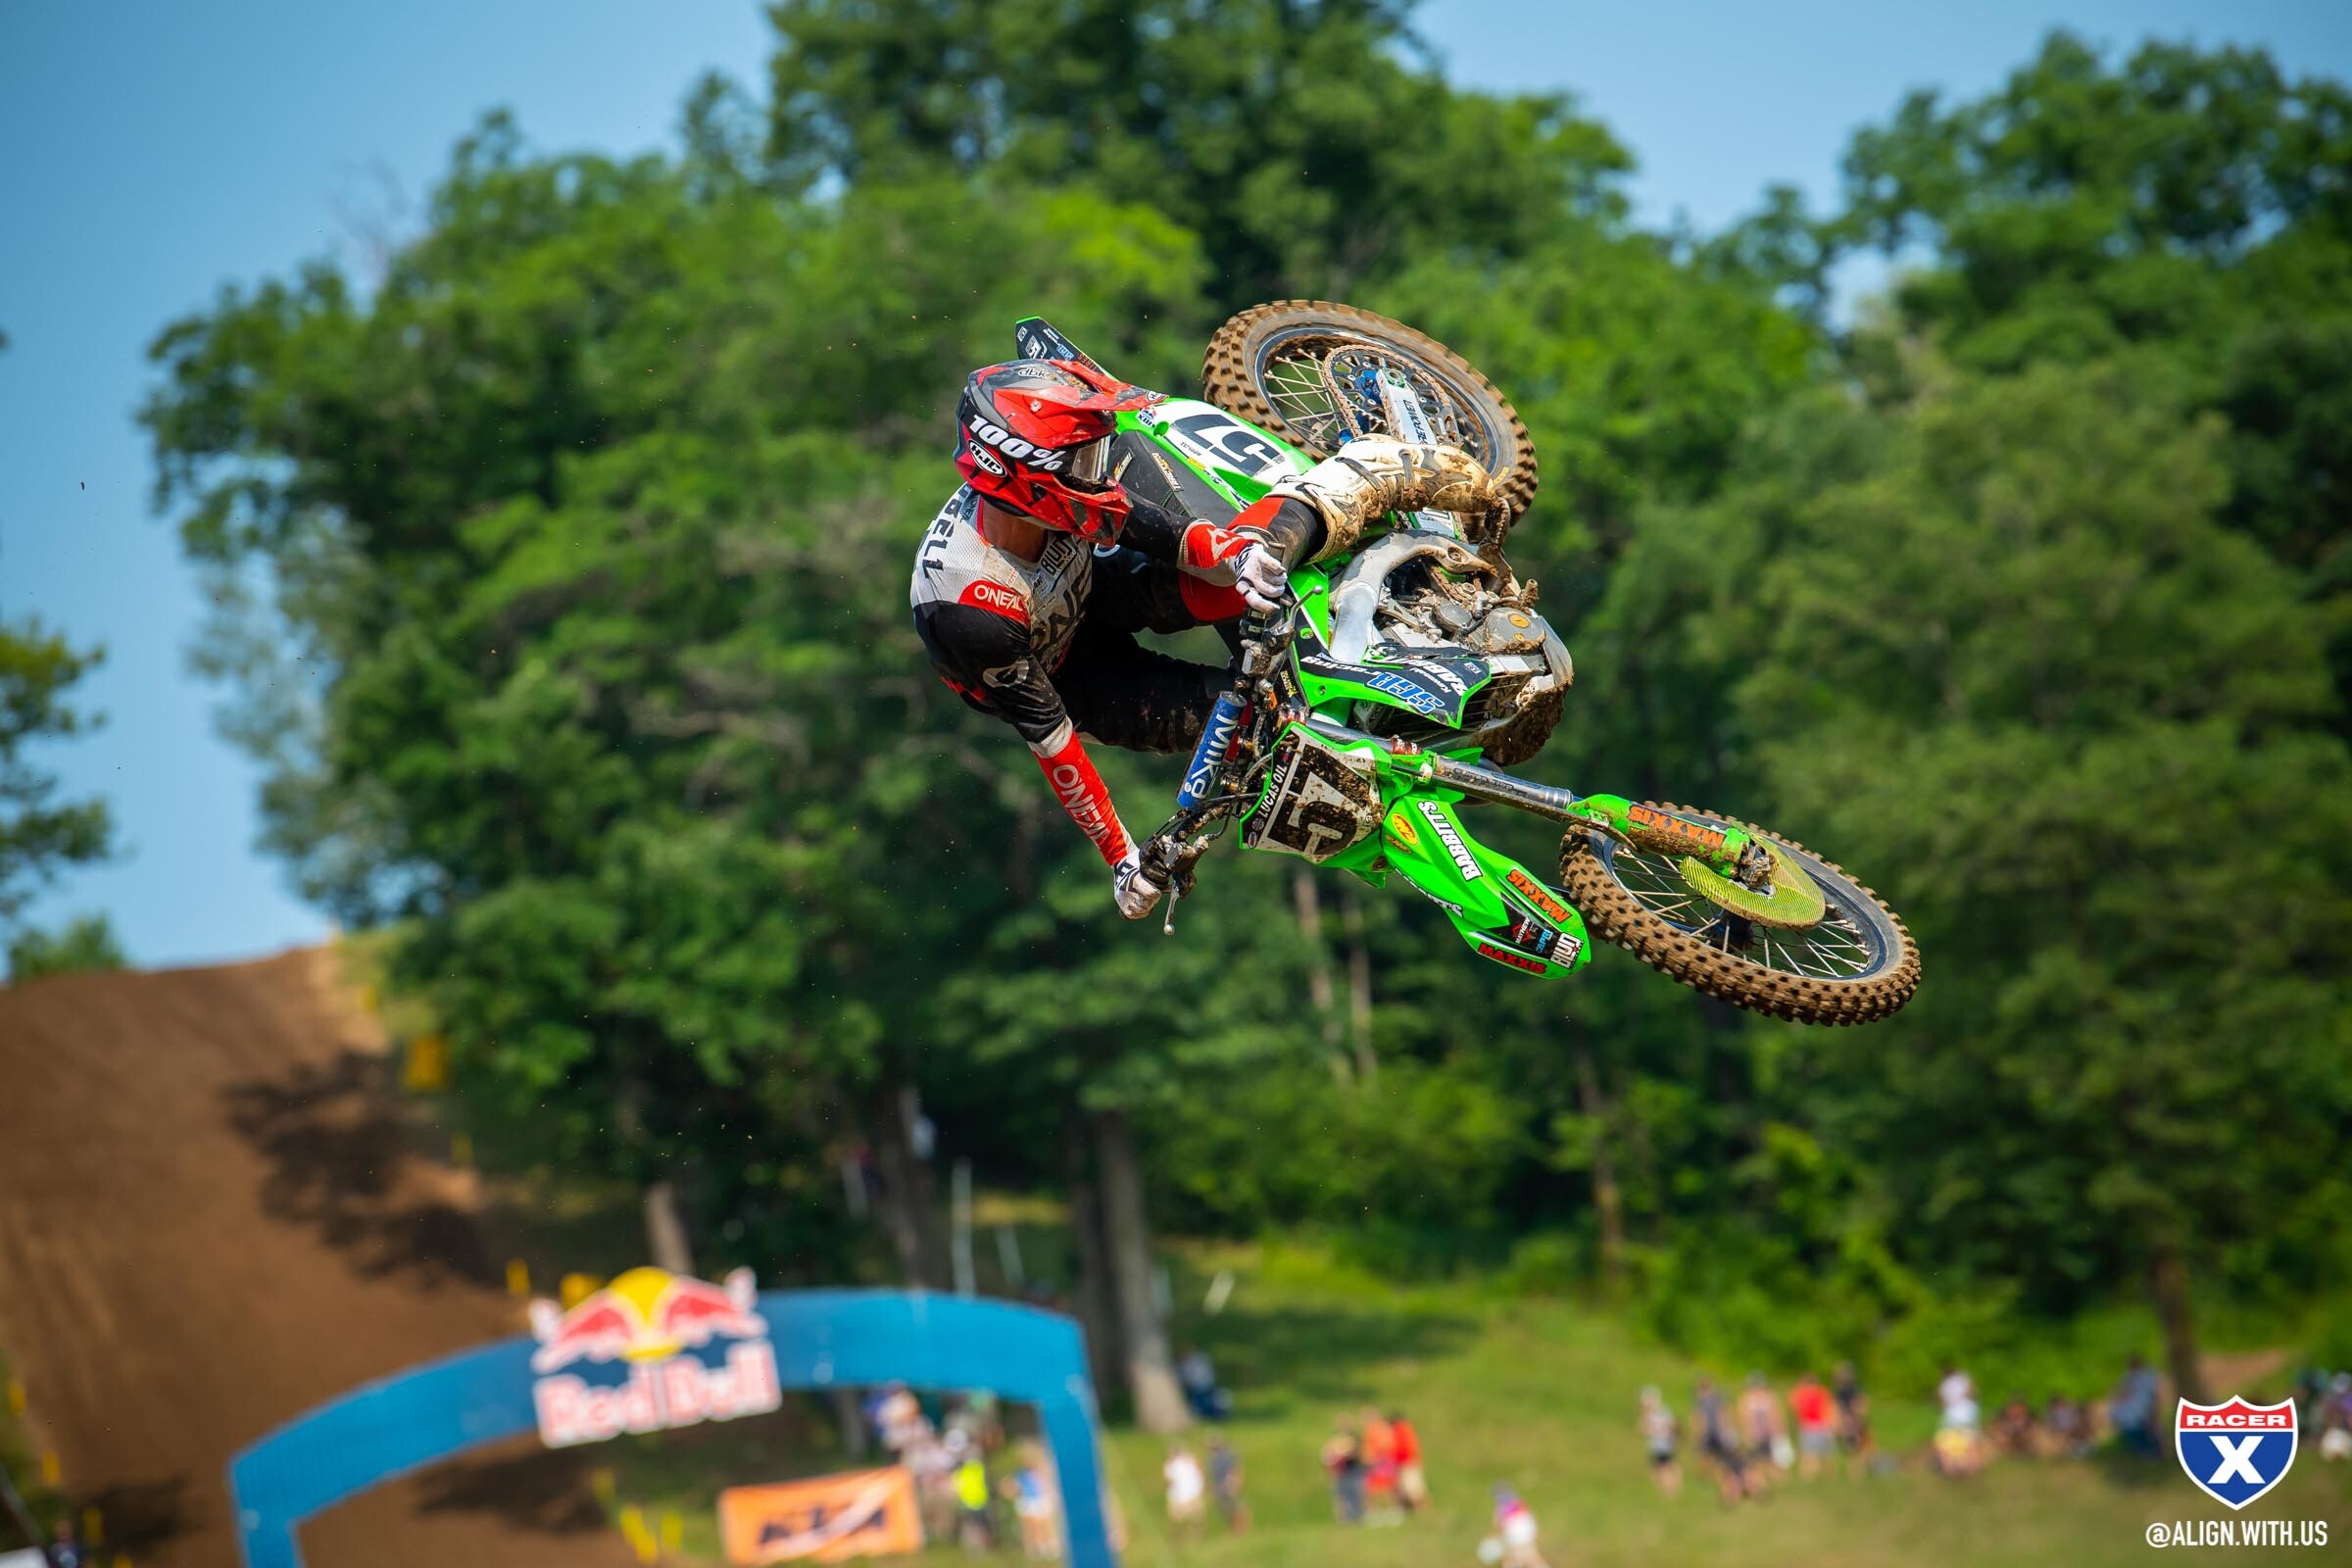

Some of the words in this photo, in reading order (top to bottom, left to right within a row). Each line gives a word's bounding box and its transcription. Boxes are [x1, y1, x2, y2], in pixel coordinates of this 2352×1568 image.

[969, 415, 1066, 470] 100%
[971, 445, 1002, 473] HJC
[1170, 415, 1281, 477] 57
[1366, 672, 1446, 713] SGB
[1258, 782, 1280, 818] LUCAS
[1273, 764, 1288, 783] OIL
[1267, 744, 1371, 855] 57
[1418, 801, 1483, 881] BABBITT'S
[1629, 806, 1726, 848] MAXXIS
[1506, 869, 1572, 923] MAXXIS
[1478, 943, 1546, 974] MAXXIS
